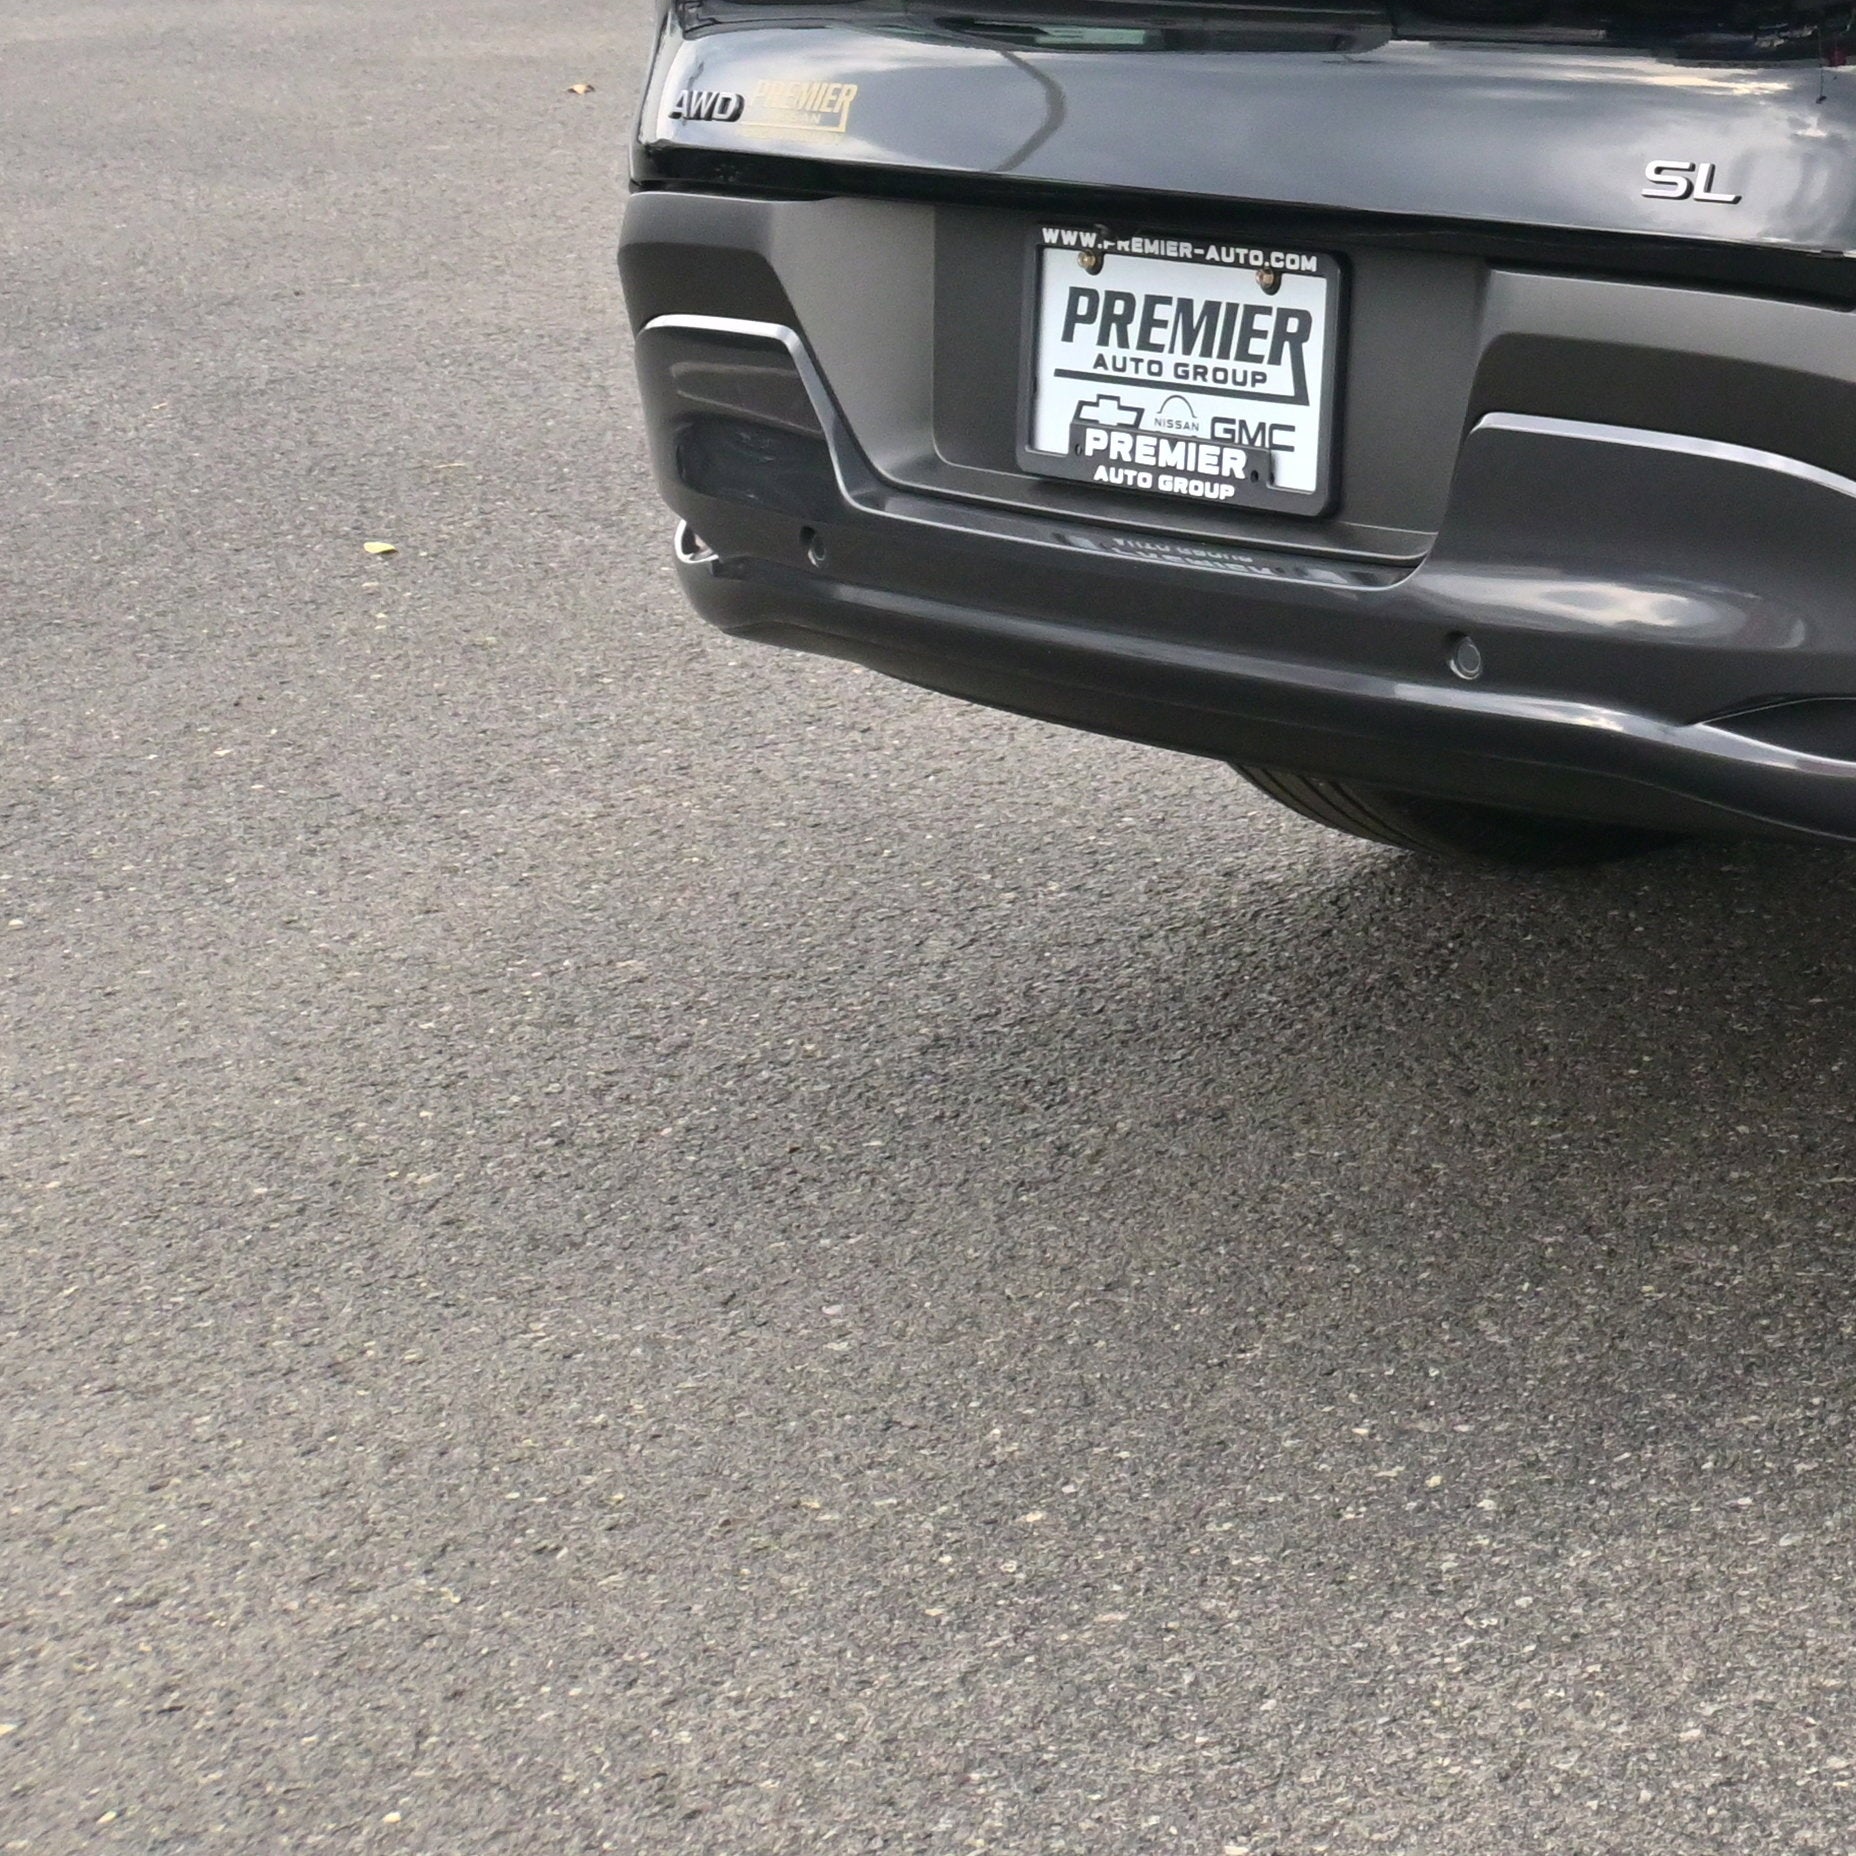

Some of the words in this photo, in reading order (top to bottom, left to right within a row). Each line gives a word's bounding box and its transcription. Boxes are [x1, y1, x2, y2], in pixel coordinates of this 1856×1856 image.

[668, 89, 745, 123] AWD
[1640, 159, 1743, 205] SL
[1060, 285, 1313, 368] PREMIER
[1092, 352, 1164, 377] AUTO
[1172, 362, 1268, 388] GROUP
[1154, 417, 1200, 432] NISSAN
[1210, 416, 1296, 452] GMC
[1084, 428, 1248, 480] PREMIER
[1093, 464, 1153, 489] AUTO
[1157, 470, 1235, 500] GROUP
